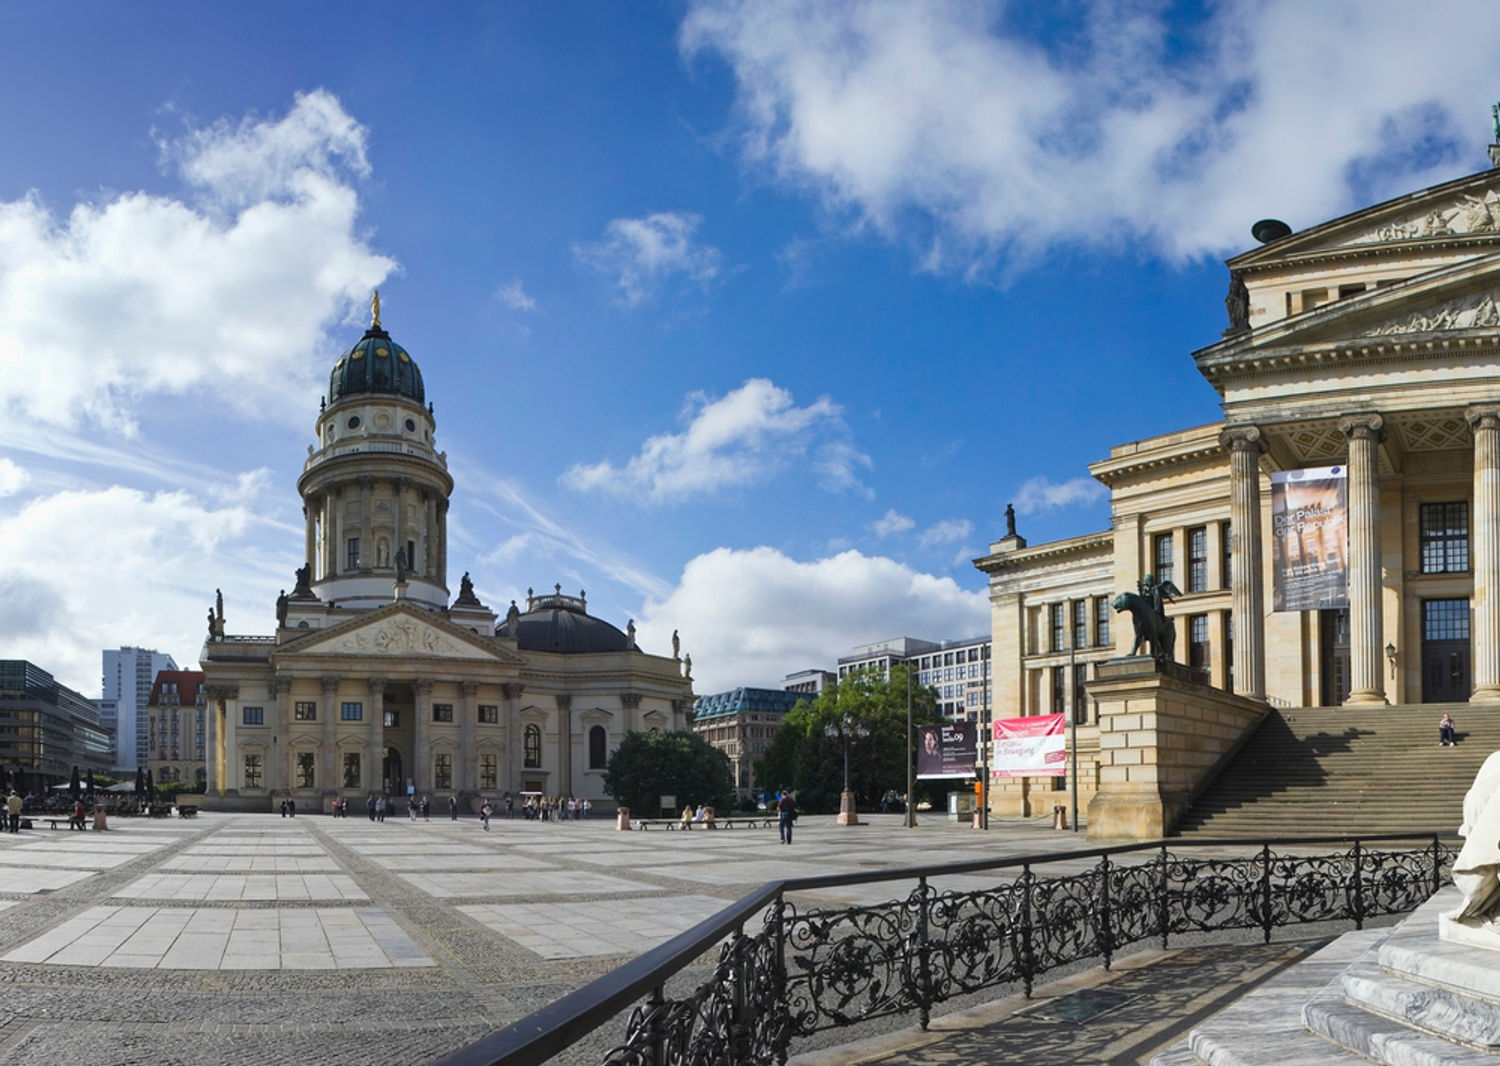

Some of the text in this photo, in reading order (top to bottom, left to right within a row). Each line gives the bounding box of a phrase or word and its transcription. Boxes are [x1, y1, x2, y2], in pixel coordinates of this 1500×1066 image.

[1274, 506, 1331, 525] Der Palast
[1276, 513, 1345, 537] der Republik
